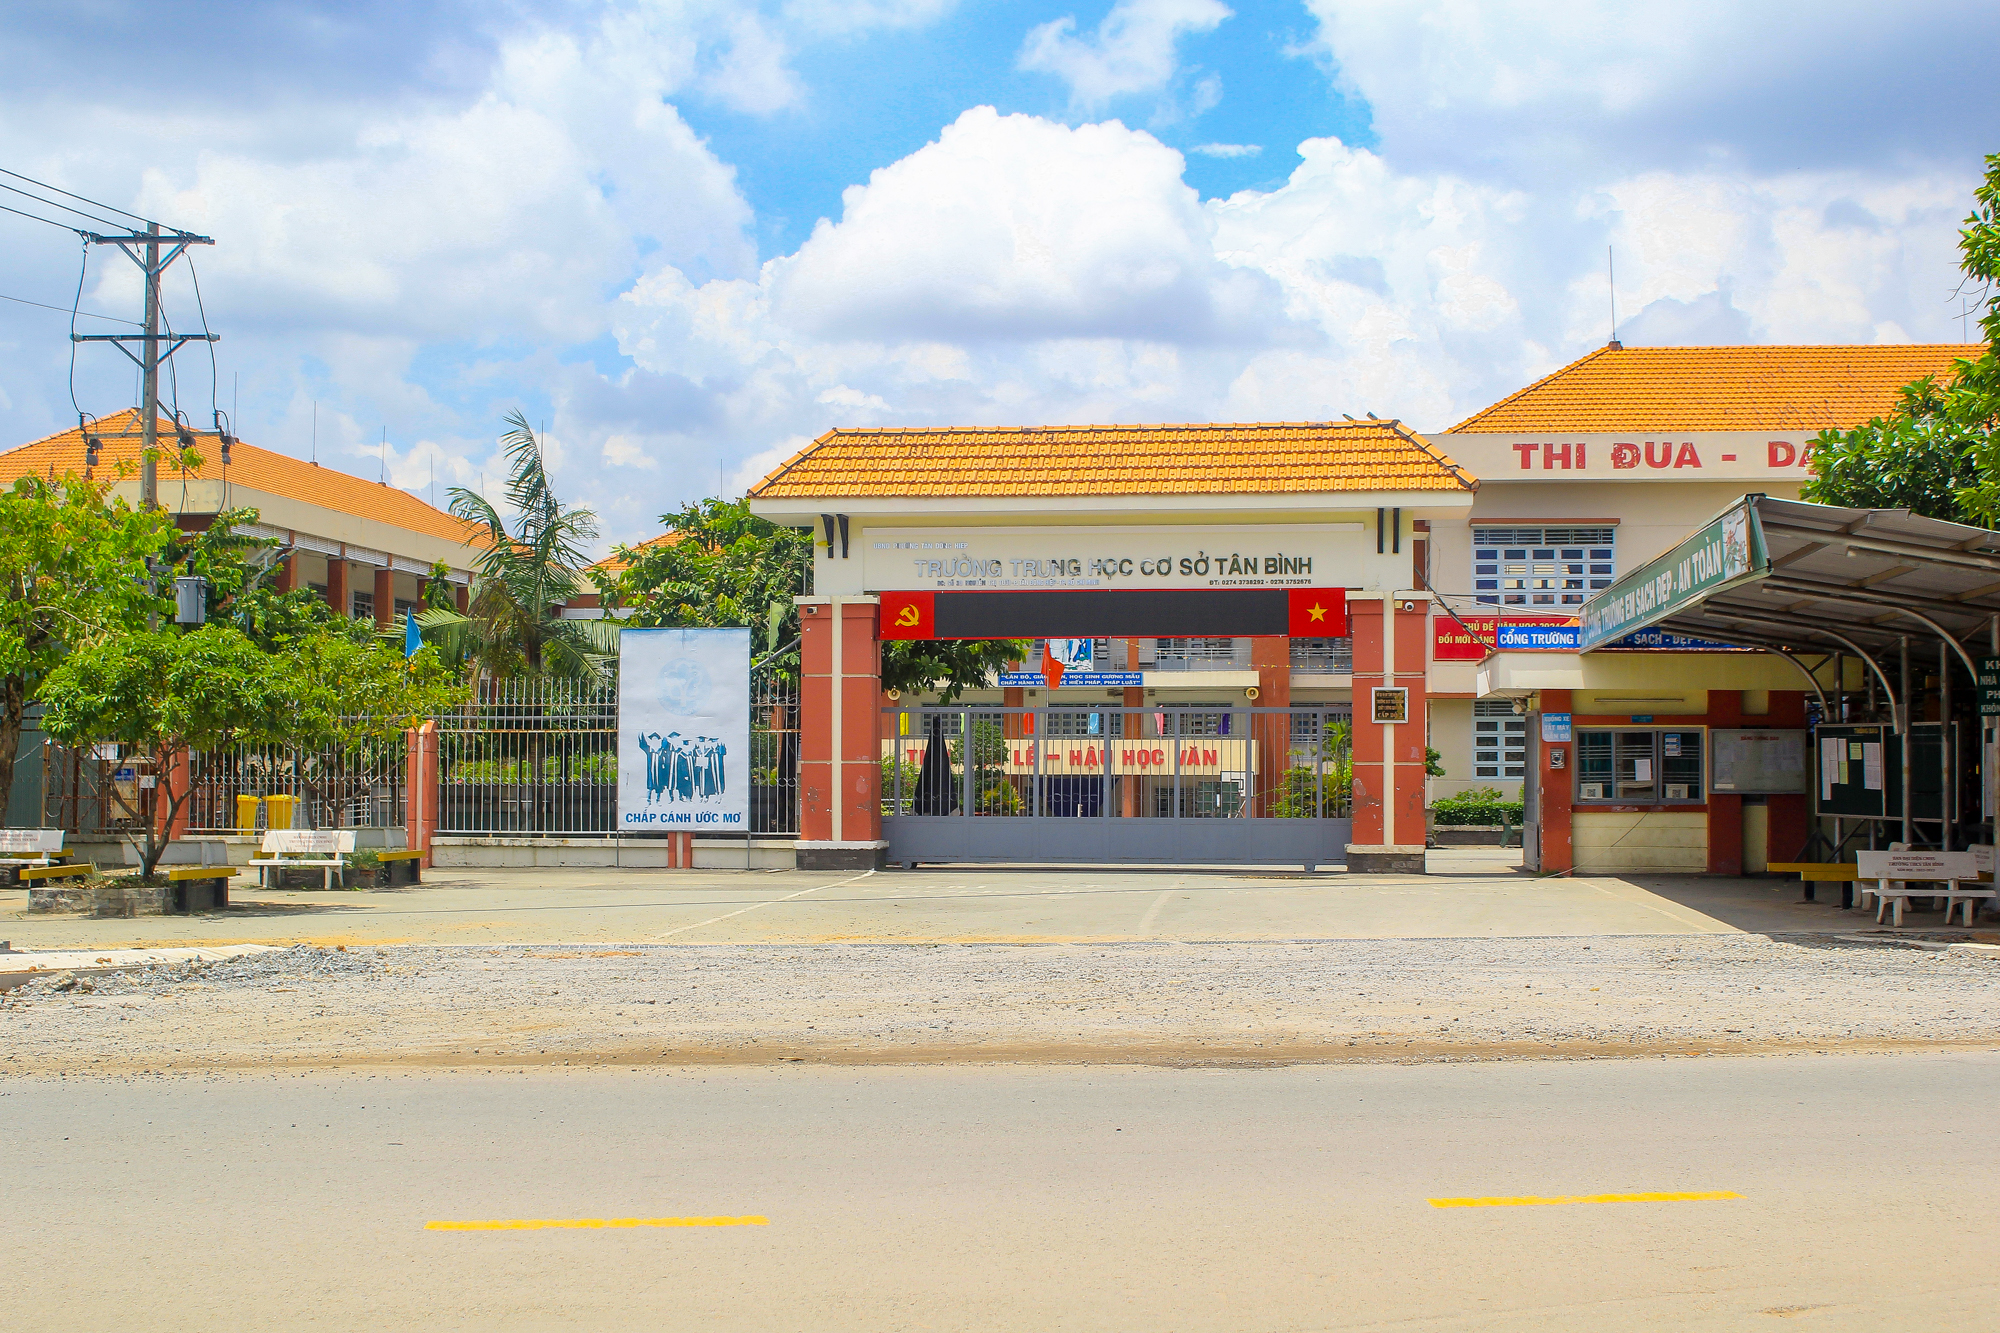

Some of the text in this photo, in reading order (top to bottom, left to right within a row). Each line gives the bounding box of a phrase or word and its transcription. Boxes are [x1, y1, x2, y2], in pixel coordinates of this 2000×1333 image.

[1512, 443, 1586, 470] THI
[1610, 441, 1702, 470] ĐUA
[914, 551, 1312, 580] TRƯỜNG TRUNG HỌC CƠ SỞ TÂN BÌNH
[1601, 596, 1625, 633] TRƯỜNG
[1625, 591, 1636, 620] EM
[1636, 580, 1656, 620] SẠCH
[1656, 570, 1673, 610] ĐẸP
[1678, 557, 1691, 594] AN
[1692, 536, 1722, 584] TOÀN
[1482, 620, 1494, 631] ĐỀ
[1438, 632, 1452, 644] ĐỔI
[1455, 634, 1471, 644] MỚI
[1500, 629, 1528, 645] CỔNG
[1531, 631, 1574, 645] TRƯỜNG
[1634, 633, 1663, 646] SẠCH
[1980, 673, 1997, 686] NHÀ
[1122, 749, 1164, 769] HỌC
[660, 811, 691, 823] CÁNH
[695, 811, 719, 823] ƯỚC
[723, 811, 741, 823] MƠ
